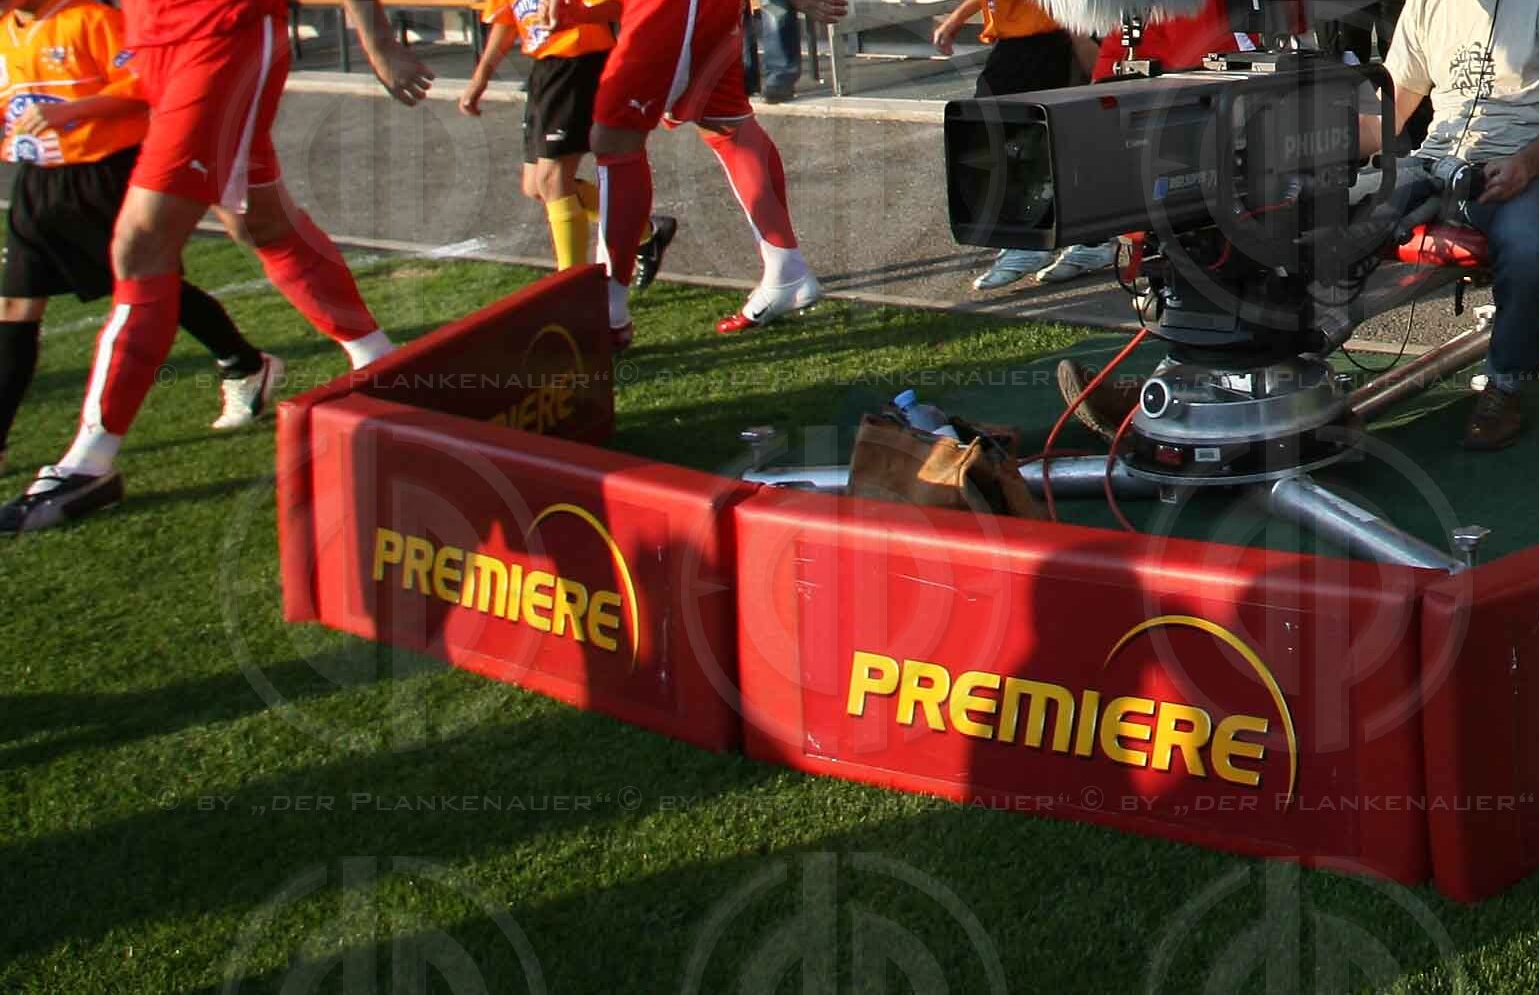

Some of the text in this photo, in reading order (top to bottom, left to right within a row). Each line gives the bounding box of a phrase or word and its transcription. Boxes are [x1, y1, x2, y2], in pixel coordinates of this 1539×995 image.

[1284, 126, 1351, 156] PHILIPS
[372, 526, 624, 653] PREMIERE
[845, 649, 1269, 787] PREMIERE
